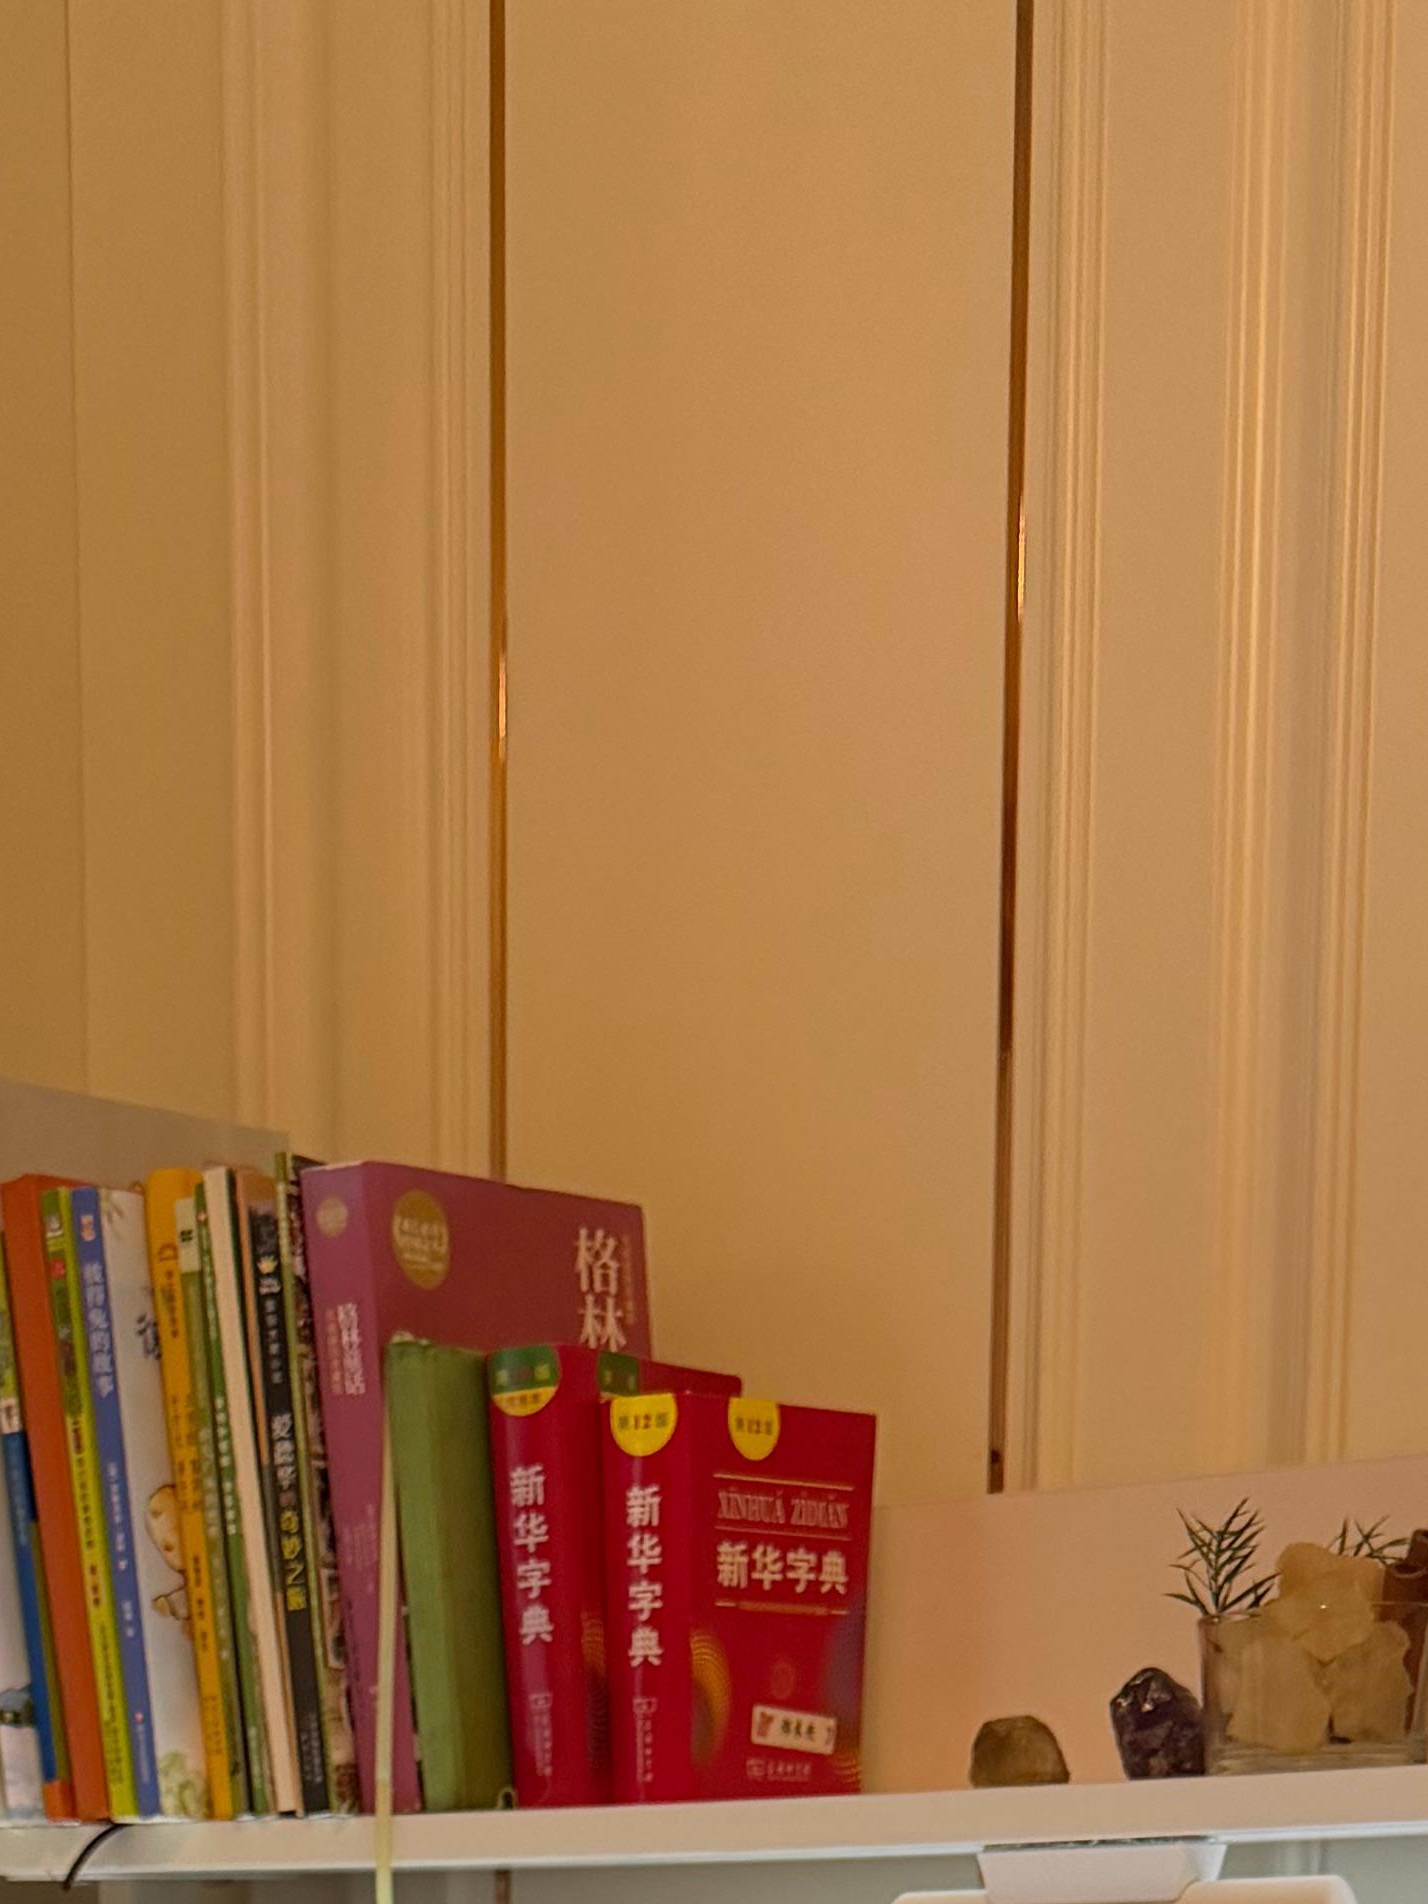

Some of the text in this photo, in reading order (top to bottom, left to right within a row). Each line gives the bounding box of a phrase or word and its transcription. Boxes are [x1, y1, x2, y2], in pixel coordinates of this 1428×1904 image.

[575, 1226, 628, 1353] 格林
[509, 1465, 553, 1646] 新华字典
[625, 1484, 664, 1668] 新华字典
[717, 1541, 849, 1595] 新华字典
